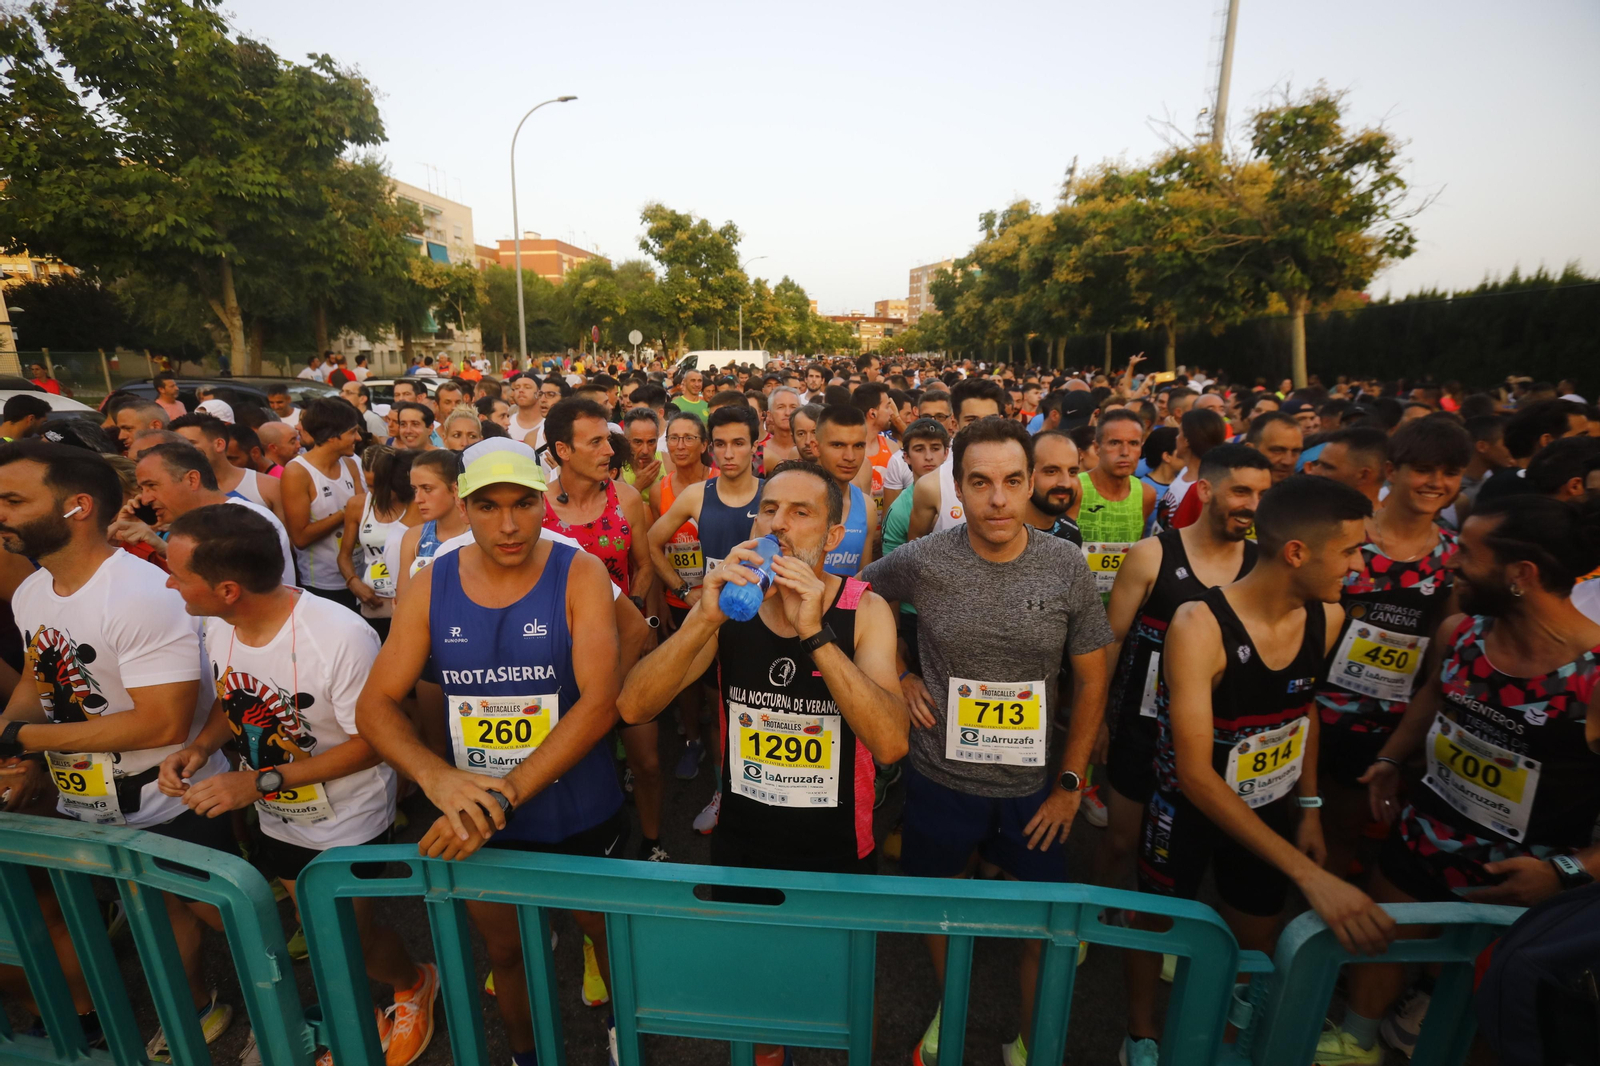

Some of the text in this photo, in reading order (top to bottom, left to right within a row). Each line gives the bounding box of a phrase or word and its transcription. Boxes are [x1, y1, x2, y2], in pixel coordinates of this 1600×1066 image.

[674, 552, 697, 566] 881
[1101, 555, 1121, 569] 65
[1369, 610, 1418, 628] CANENA
[1364, 645, 1409, 669] 450
[441, 664, 557, 685] TROTASIERRA
[748, 689, 792, 710] NOCTURNA
[793, 698, 804, 713] DE
[981, 690, 1016, 698] TROTACALLES
[483, 705, 521, 714] TROTACALLES
[974, 701, 1025, 726] 713
[1446, 690, 1526, 735] ARMENTEROS
[477, 718, 532, 745] 260
[763, 719, 802, 732] TROTACALLES
[1465, 713, 1509, 743] TIERRAS
[748, 731, 823, 763] 1290
[981, 734, 1034, 745] laArruzafa
[1252, 739, 1293, 773] 814
[1448, 743, 1502, 788] 700
[53, 771, 87, 792] 59
[765, 771, 824, 784] laArruzafa
[1451, 778, 1511, 815] laArruzafa
